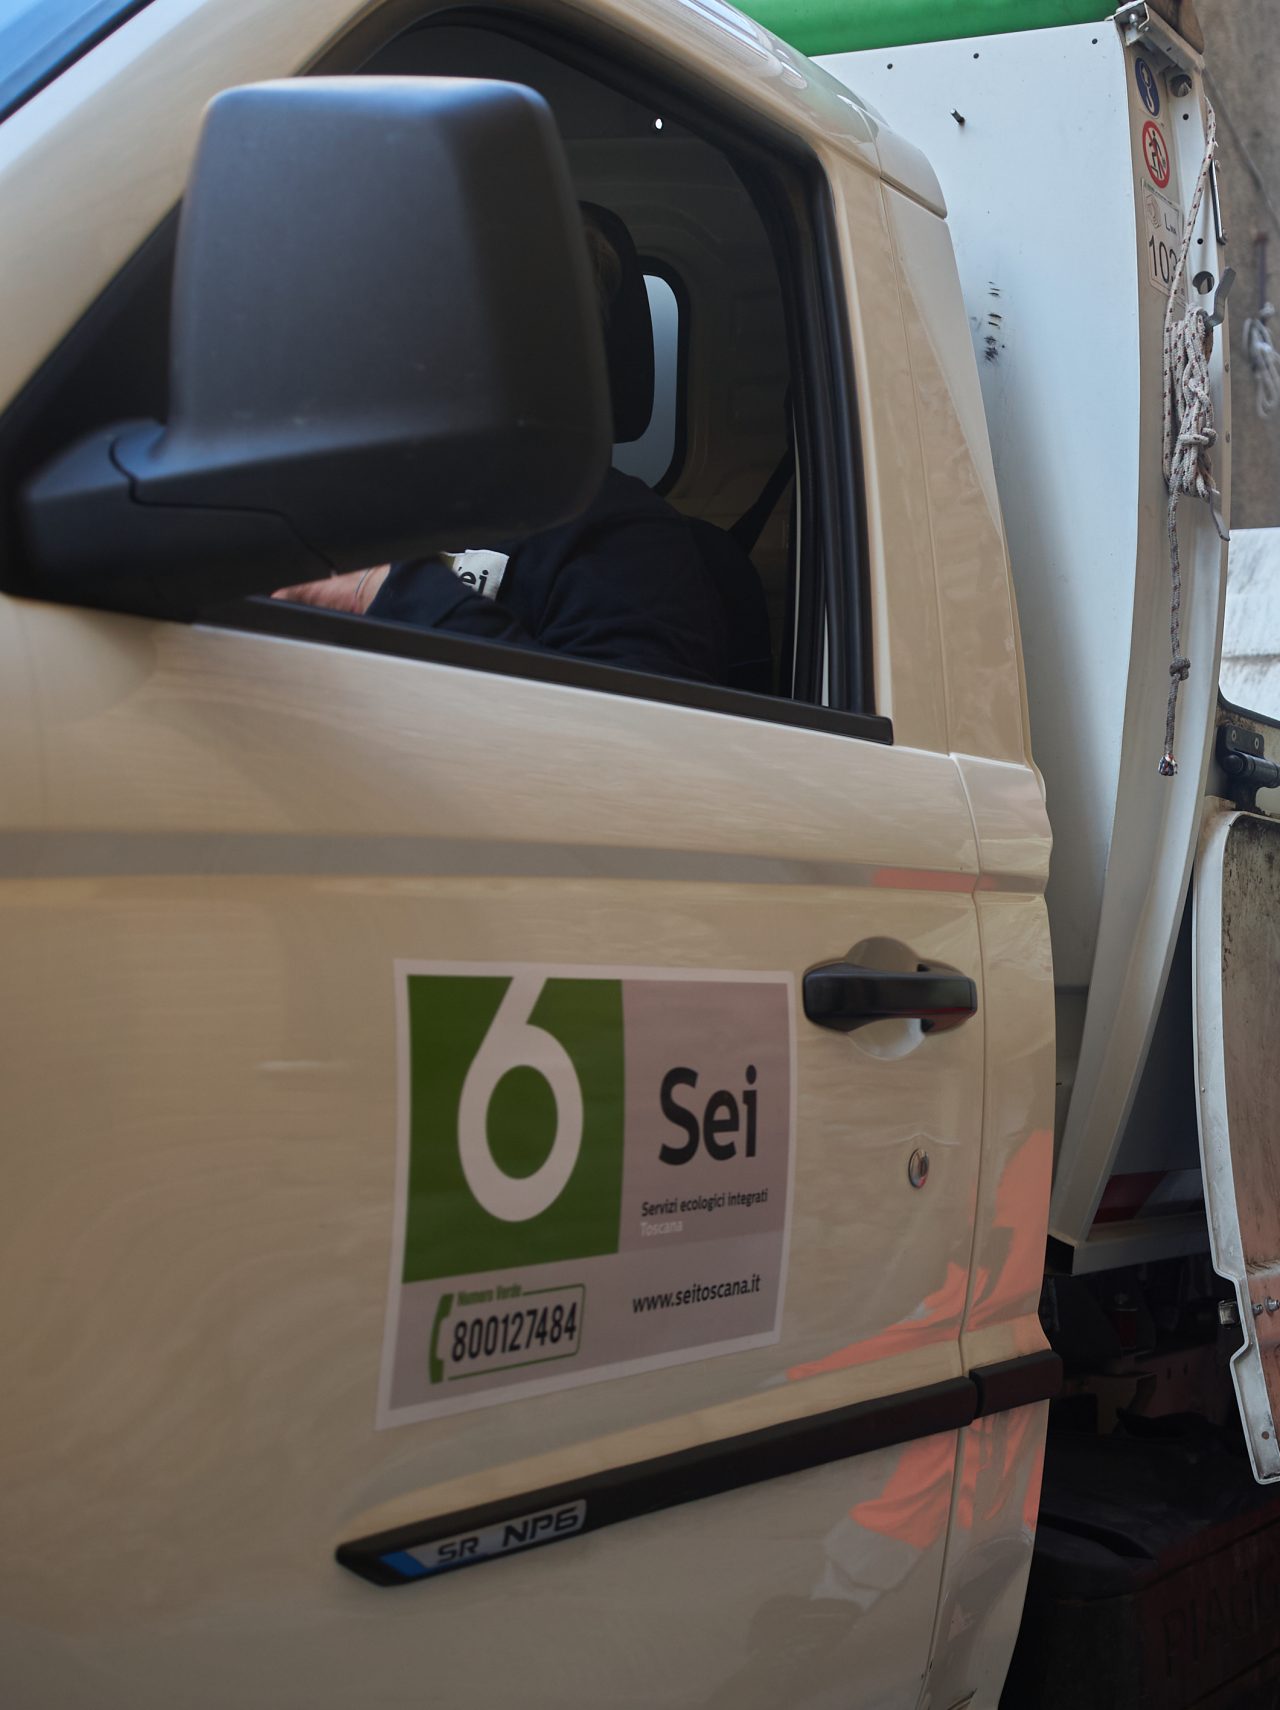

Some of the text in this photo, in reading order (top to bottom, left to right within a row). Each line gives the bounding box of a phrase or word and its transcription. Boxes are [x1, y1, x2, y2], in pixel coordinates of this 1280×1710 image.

[458, 566, 490, 595] ei
[457, 974, 758, 1223] 6 Sei
[641, 1188, 768, 1217] Servizi ecologici integrati
[640, 1220, 683, 1236] Toscana
[632, 1273, 760, 1313] www.seitoscana.it
[451, 1303, 577, 1363] 800127484
[437, 1506, 579, 1564] SR NP6
